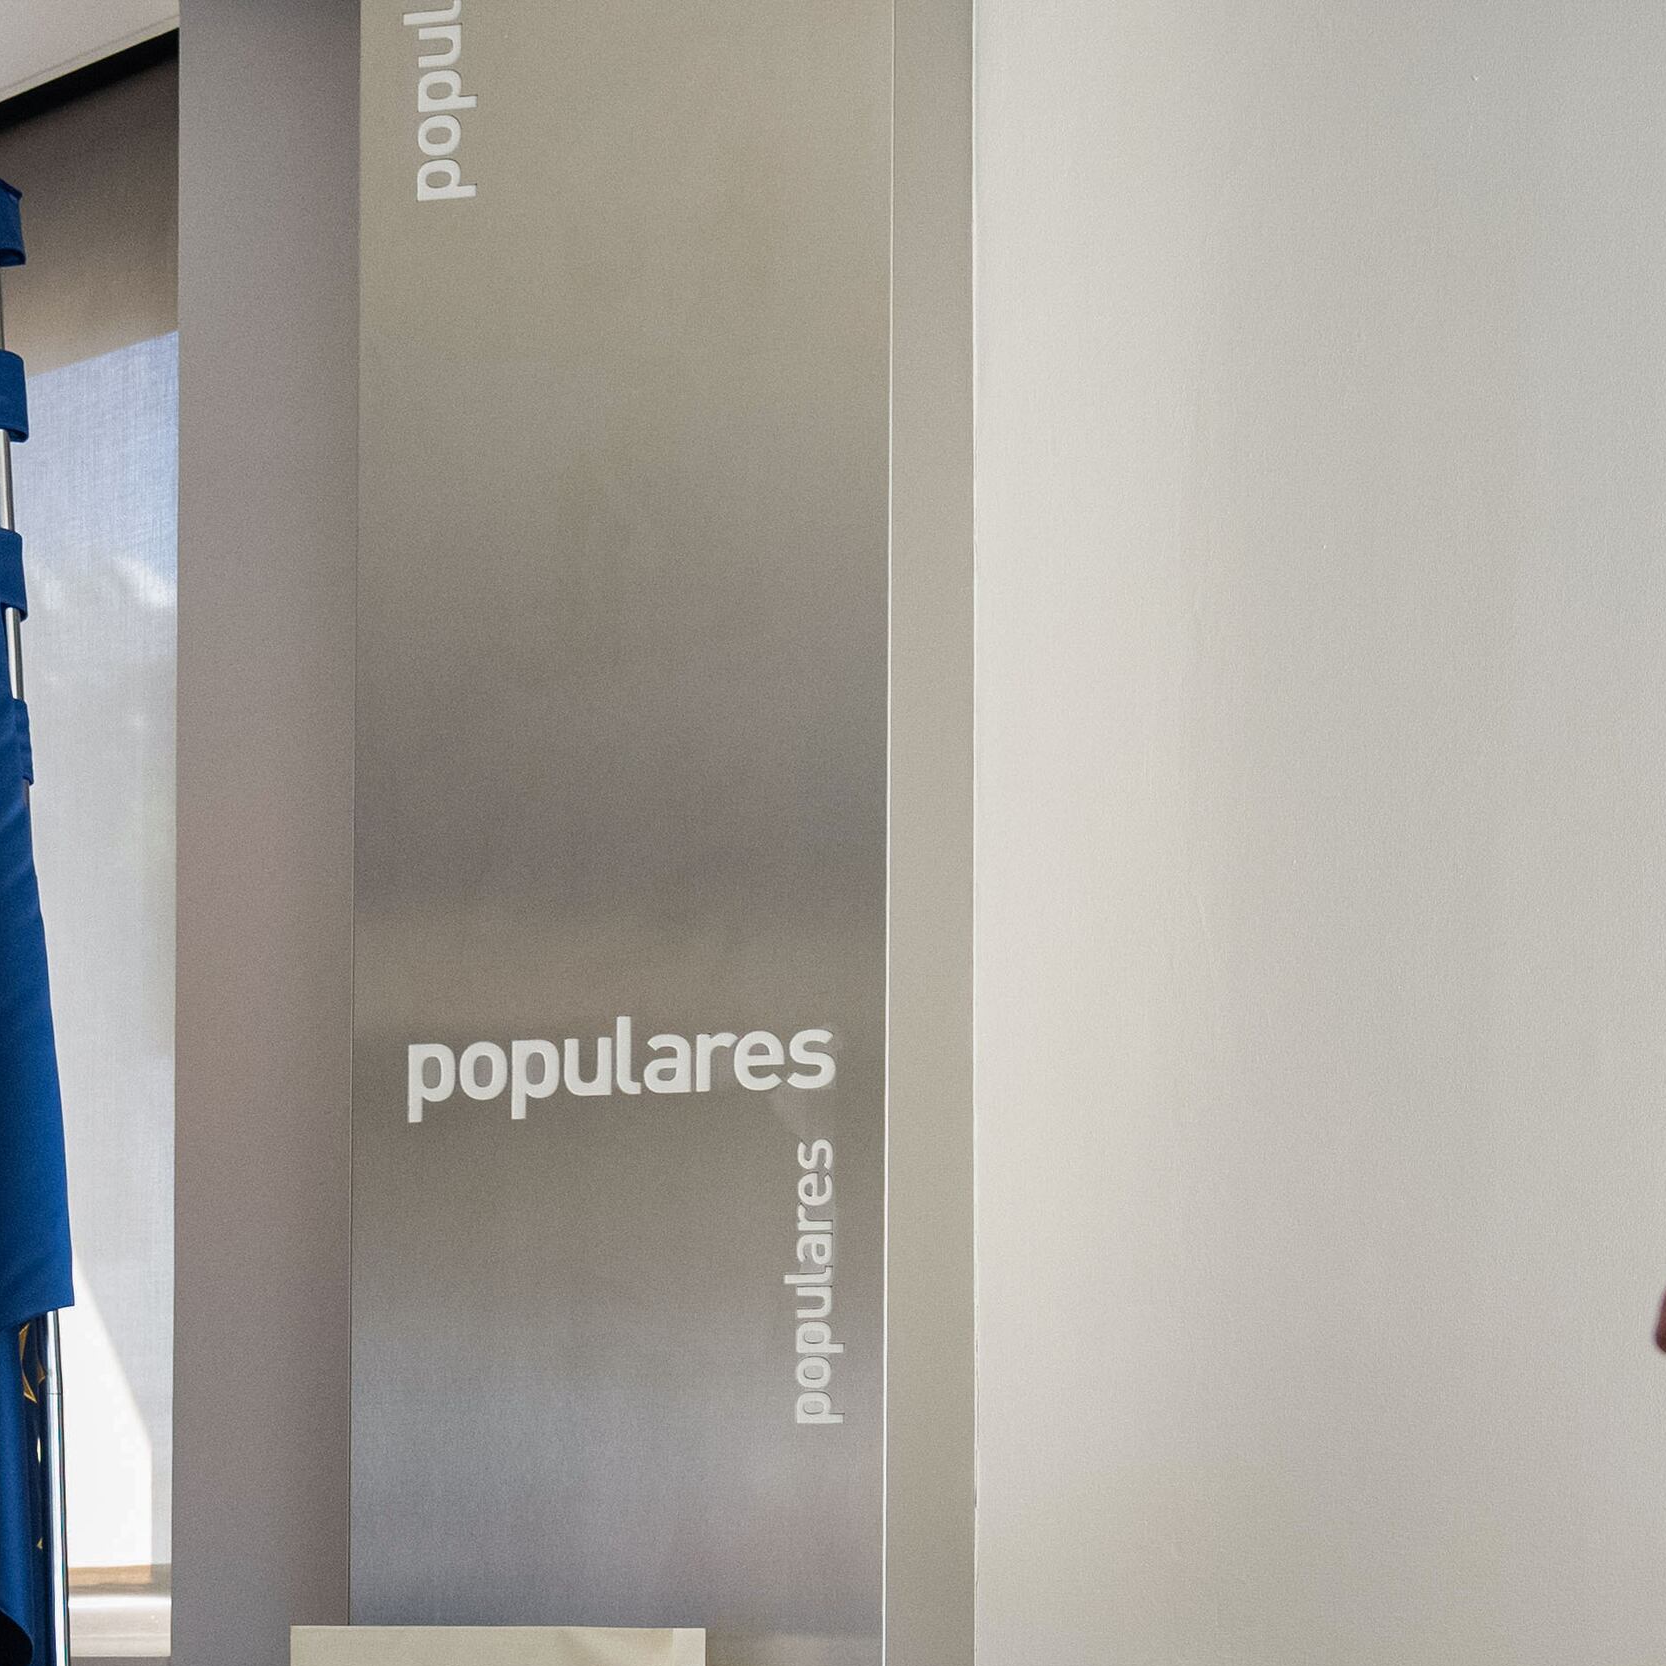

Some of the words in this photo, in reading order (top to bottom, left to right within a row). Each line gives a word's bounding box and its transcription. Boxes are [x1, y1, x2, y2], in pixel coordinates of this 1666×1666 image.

[402, 0, 478, 202] popul
[408, 1015, 836, 1123] populares
[783, 1137, 845, 1424] populares
